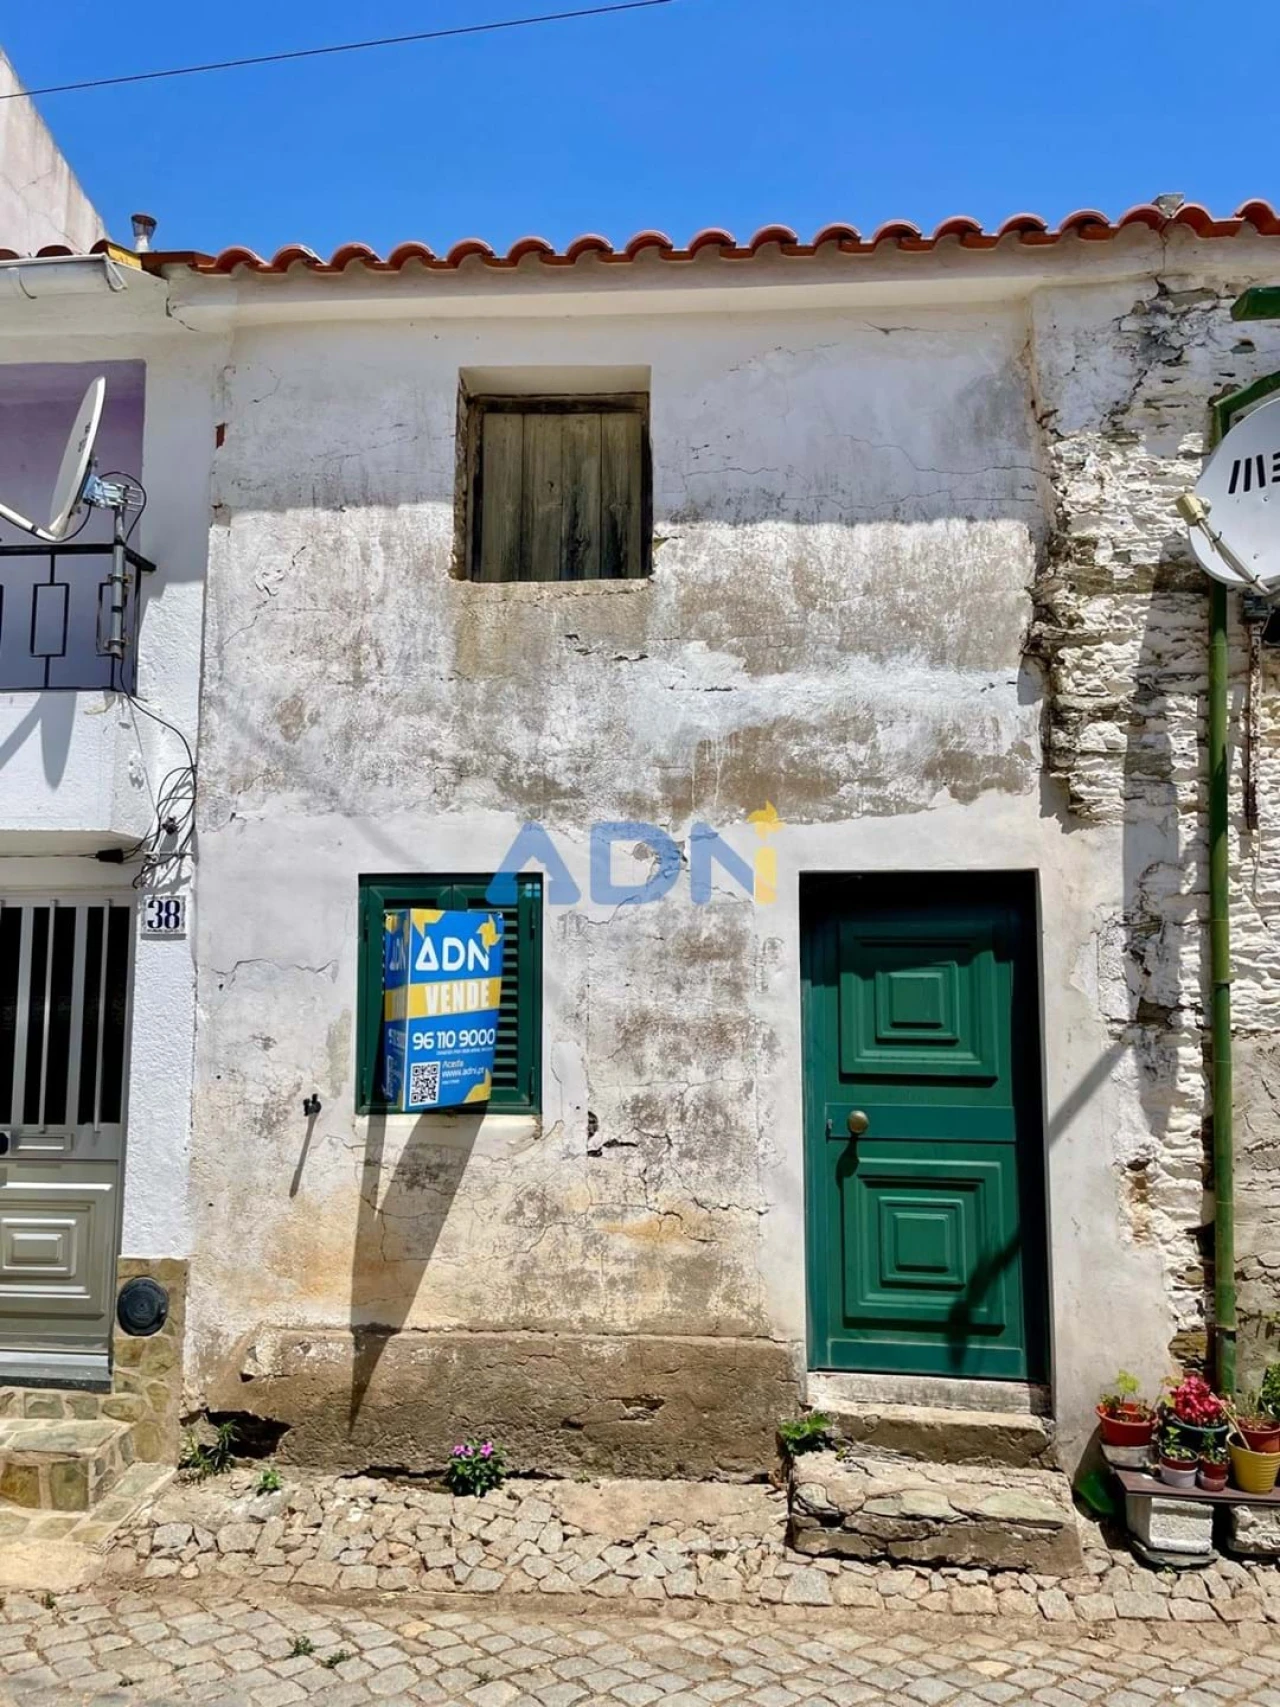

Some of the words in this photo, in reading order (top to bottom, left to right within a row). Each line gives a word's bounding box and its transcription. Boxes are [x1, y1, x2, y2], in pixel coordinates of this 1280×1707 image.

[147, 900, 180, 929] 38
[415, 936, 490, 971] ADN
[425, 980, 490, 1016] VENDE
[412, 1031, 434, 1050] 96
[436, 1030, 456, 1049] 110
[458, 1028, 495, 1047] 9000
